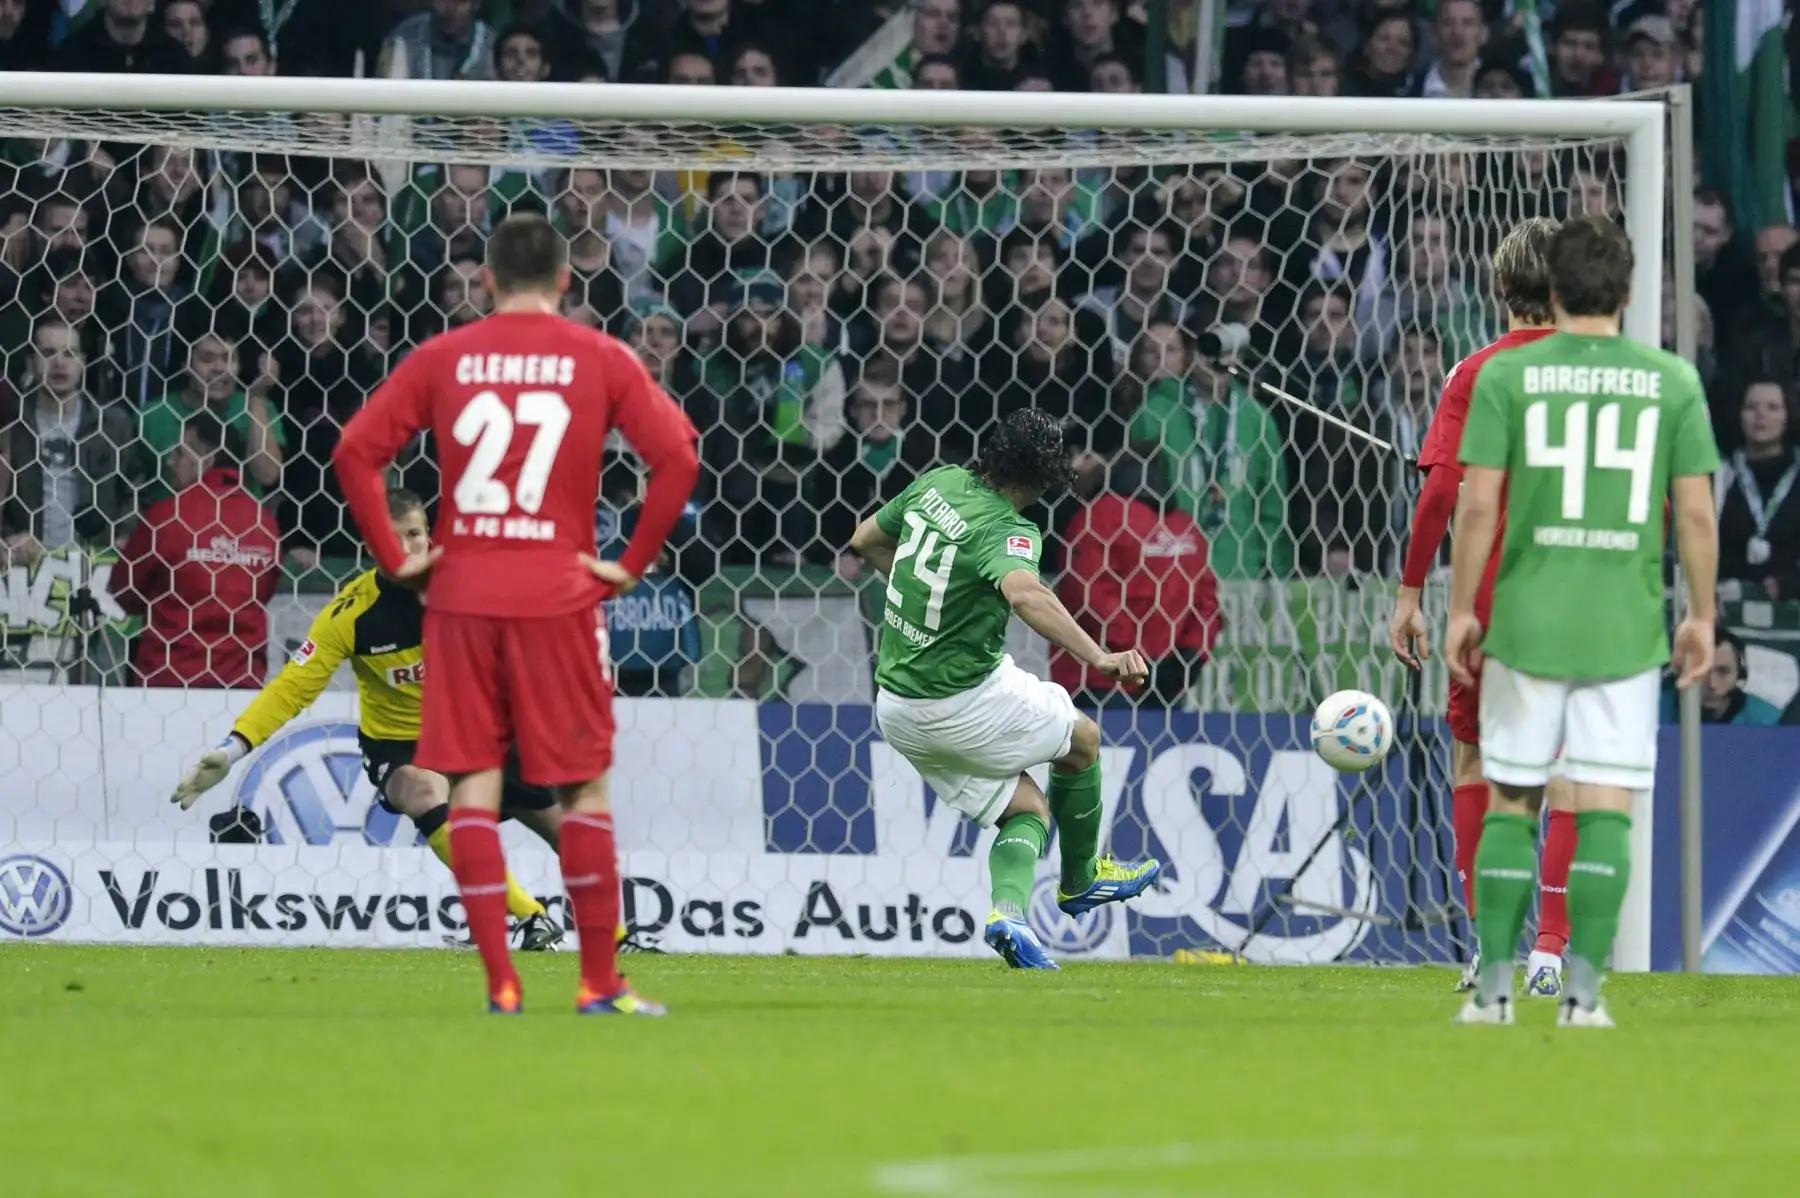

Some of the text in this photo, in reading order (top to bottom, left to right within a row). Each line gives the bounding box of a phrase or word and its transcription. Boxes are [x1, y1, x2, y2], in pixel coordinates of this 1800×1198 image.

[455, 353, 576, 385] CLEMENS
[1523, 364, 1662, 399] BARGFREDE
[452, 390, 572, 515] 27
[1524, 400, 1660, 524] 44
[918, 487, 969, 541] PIZARRO
[886, 510, 958, 631] 24
[393, 661, 426, 685] RE
[97, 868, 976, 944] Volkswagn Das Auto
